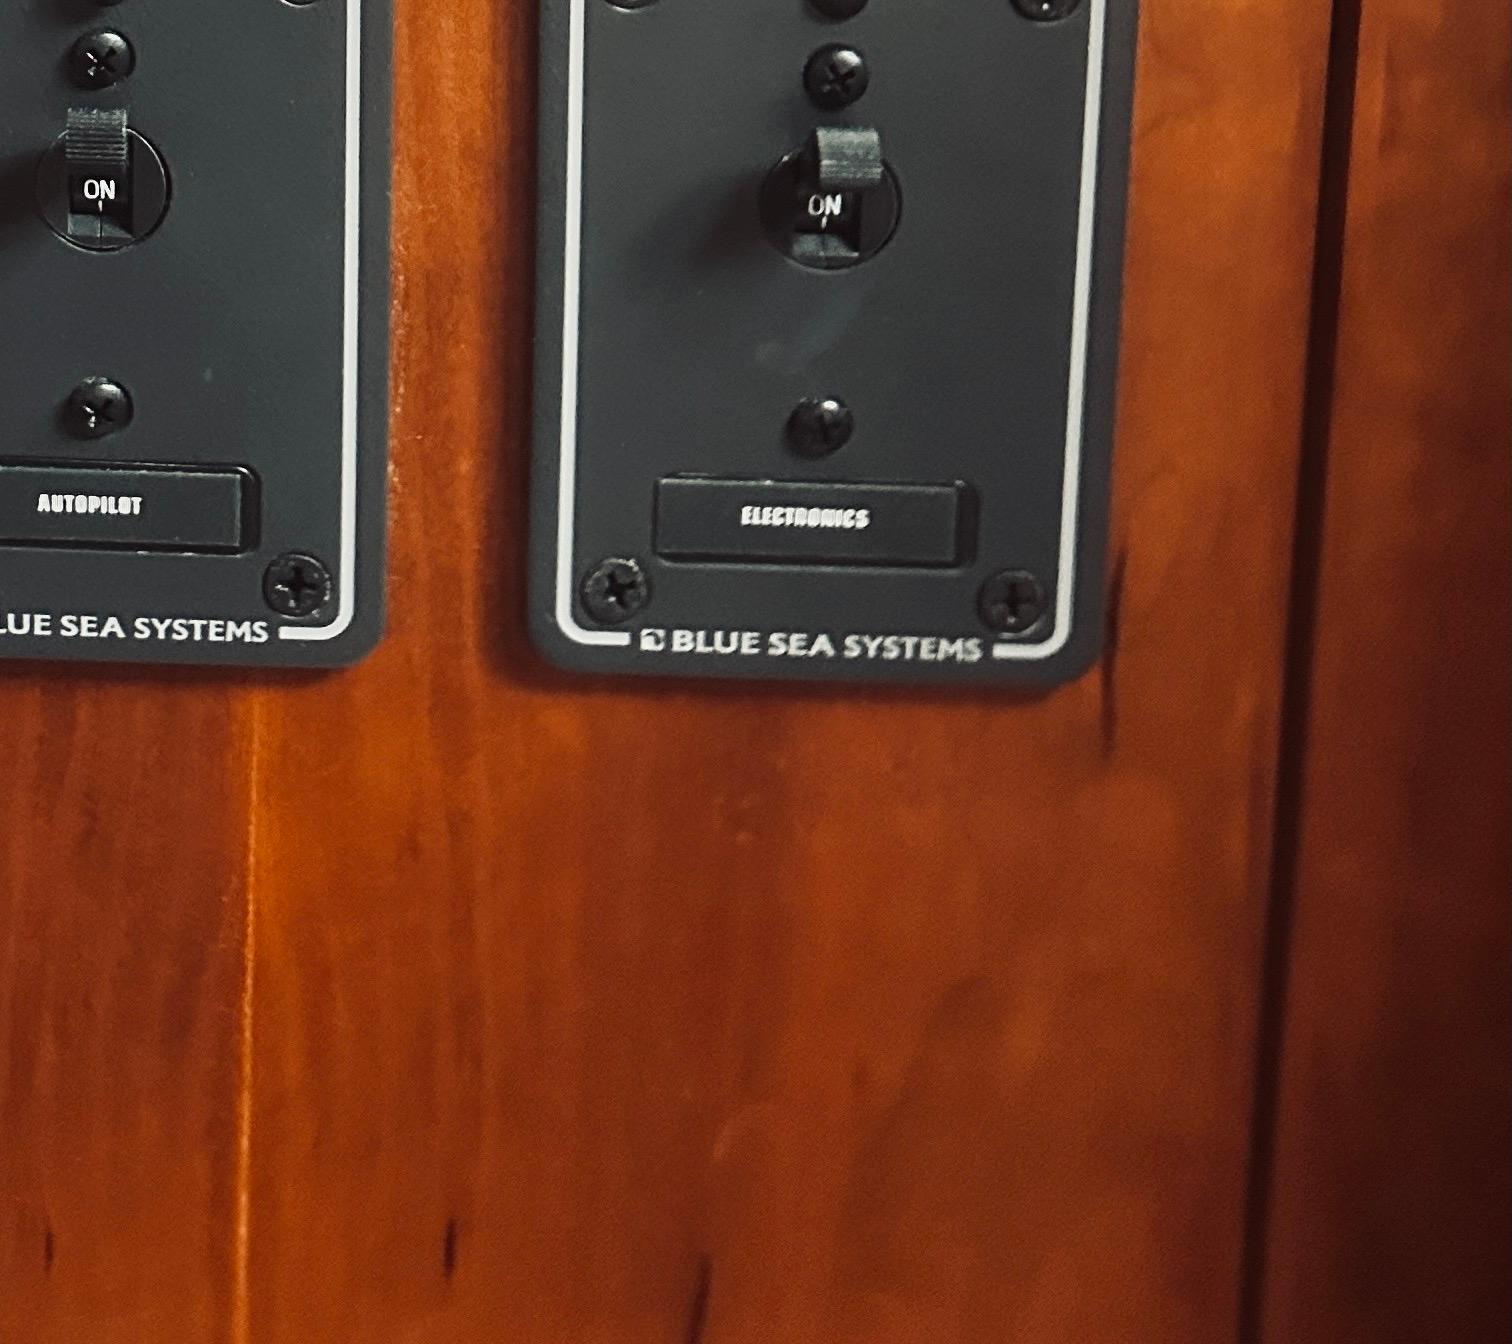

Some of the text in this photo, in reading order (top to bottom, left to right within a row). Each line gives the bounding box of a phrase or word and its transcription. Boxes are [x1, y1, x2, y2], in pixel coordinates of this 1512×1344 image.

[83, 180, 115, 200] ON
[808, 194, 842, 216] ON
[37, 494, 142, 514] AUTOPILOT
[741, 505, 871, 529] ELECTRONICS
[60, 614, 126, 638] SEA
[133, 617, 268, 642] SYSTEMS
[672, 629, 981, 662] BLUE SEA SYSTEMS
